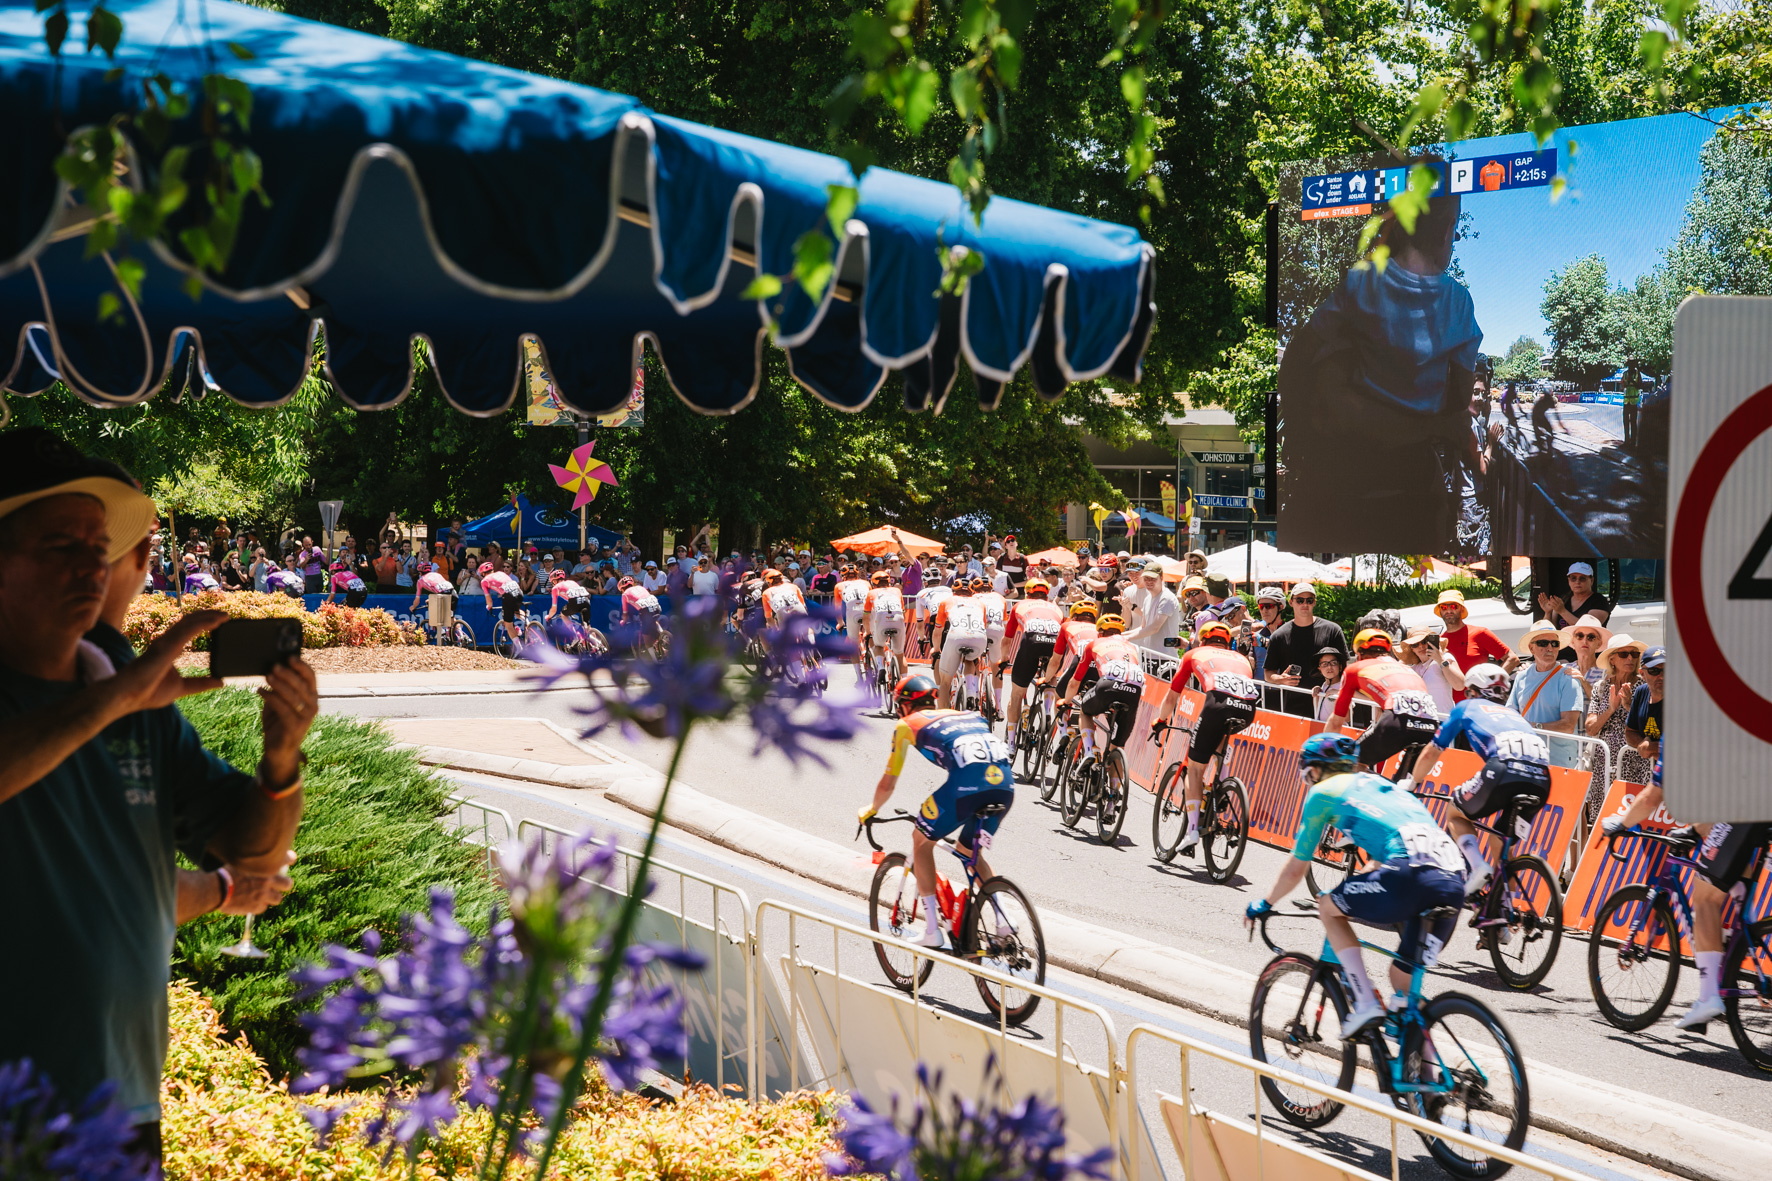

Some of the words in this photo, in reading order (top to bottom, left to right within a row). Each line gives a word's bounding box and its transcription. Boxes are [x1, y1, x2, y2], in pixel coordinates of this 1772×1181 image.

[1514, 156, 1533, 167] GAP
[1457, 169, 1467, 183] P
[1391, 175, 1398, 191] 1
[1332, 207, 1354, 216] STAGE
[1200, 453, 1235, 462] JOHNSTON
[1199, 497, 1223, 506] MEDICAL
[1226, 498, 1244, 507] CLINIC
[1028, 622, 1045, 633] 165
[1180, 694, 1196, 716] Santos
[1237, 720, 1271, 741] antos
